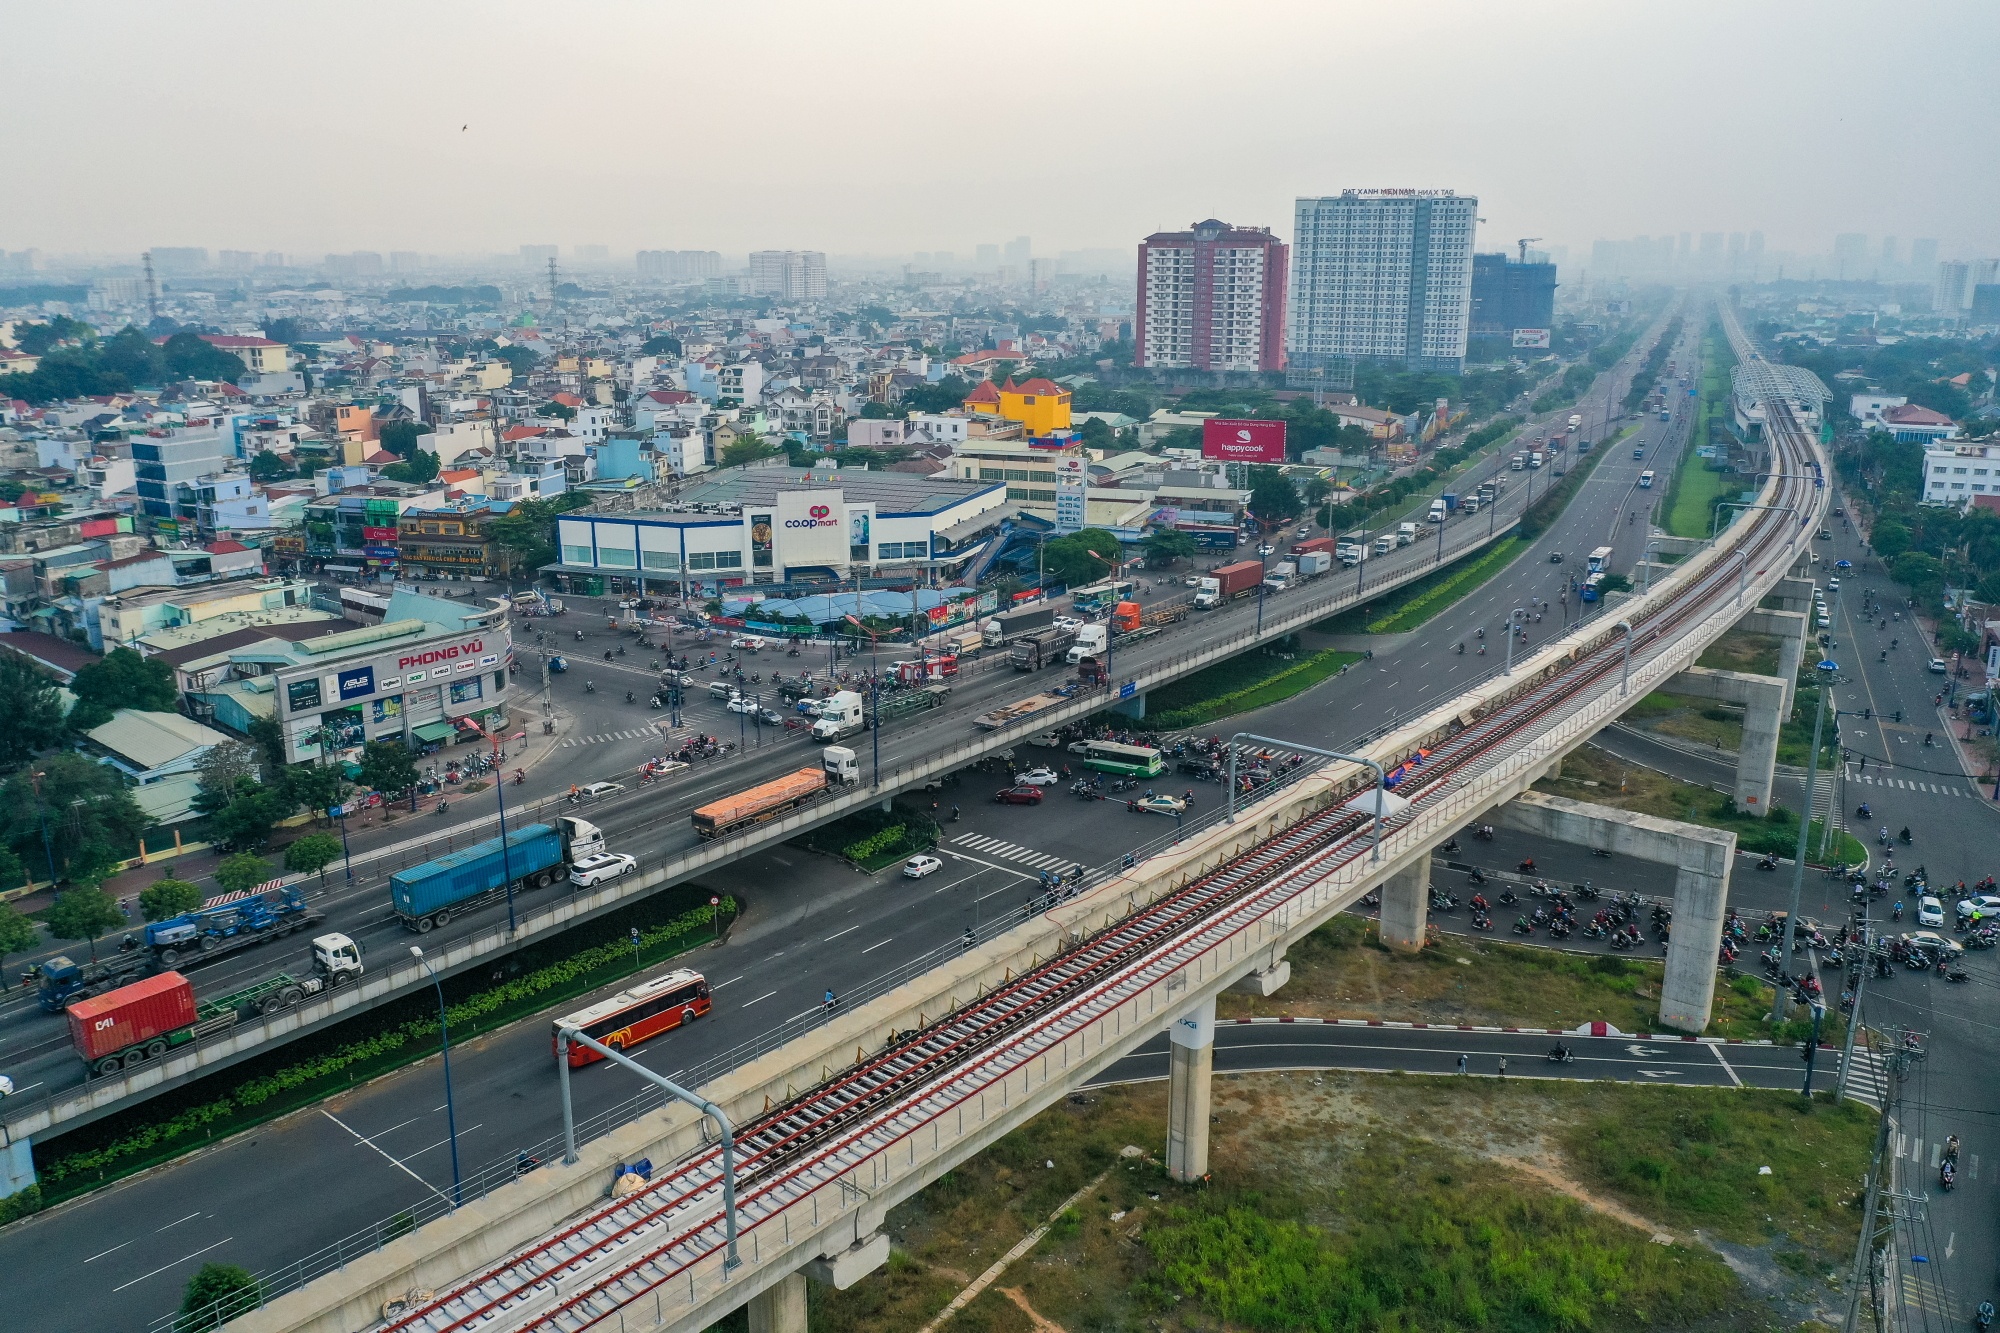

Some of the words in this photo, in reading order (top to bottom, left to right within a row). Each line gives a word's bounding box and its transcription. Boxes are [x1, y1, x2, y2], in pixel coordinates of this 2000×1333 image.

[399, 647, 459, 669] PHONG
[461, 639, 483, 654] VŨ
[343, 676, 368, 687] ASUS
